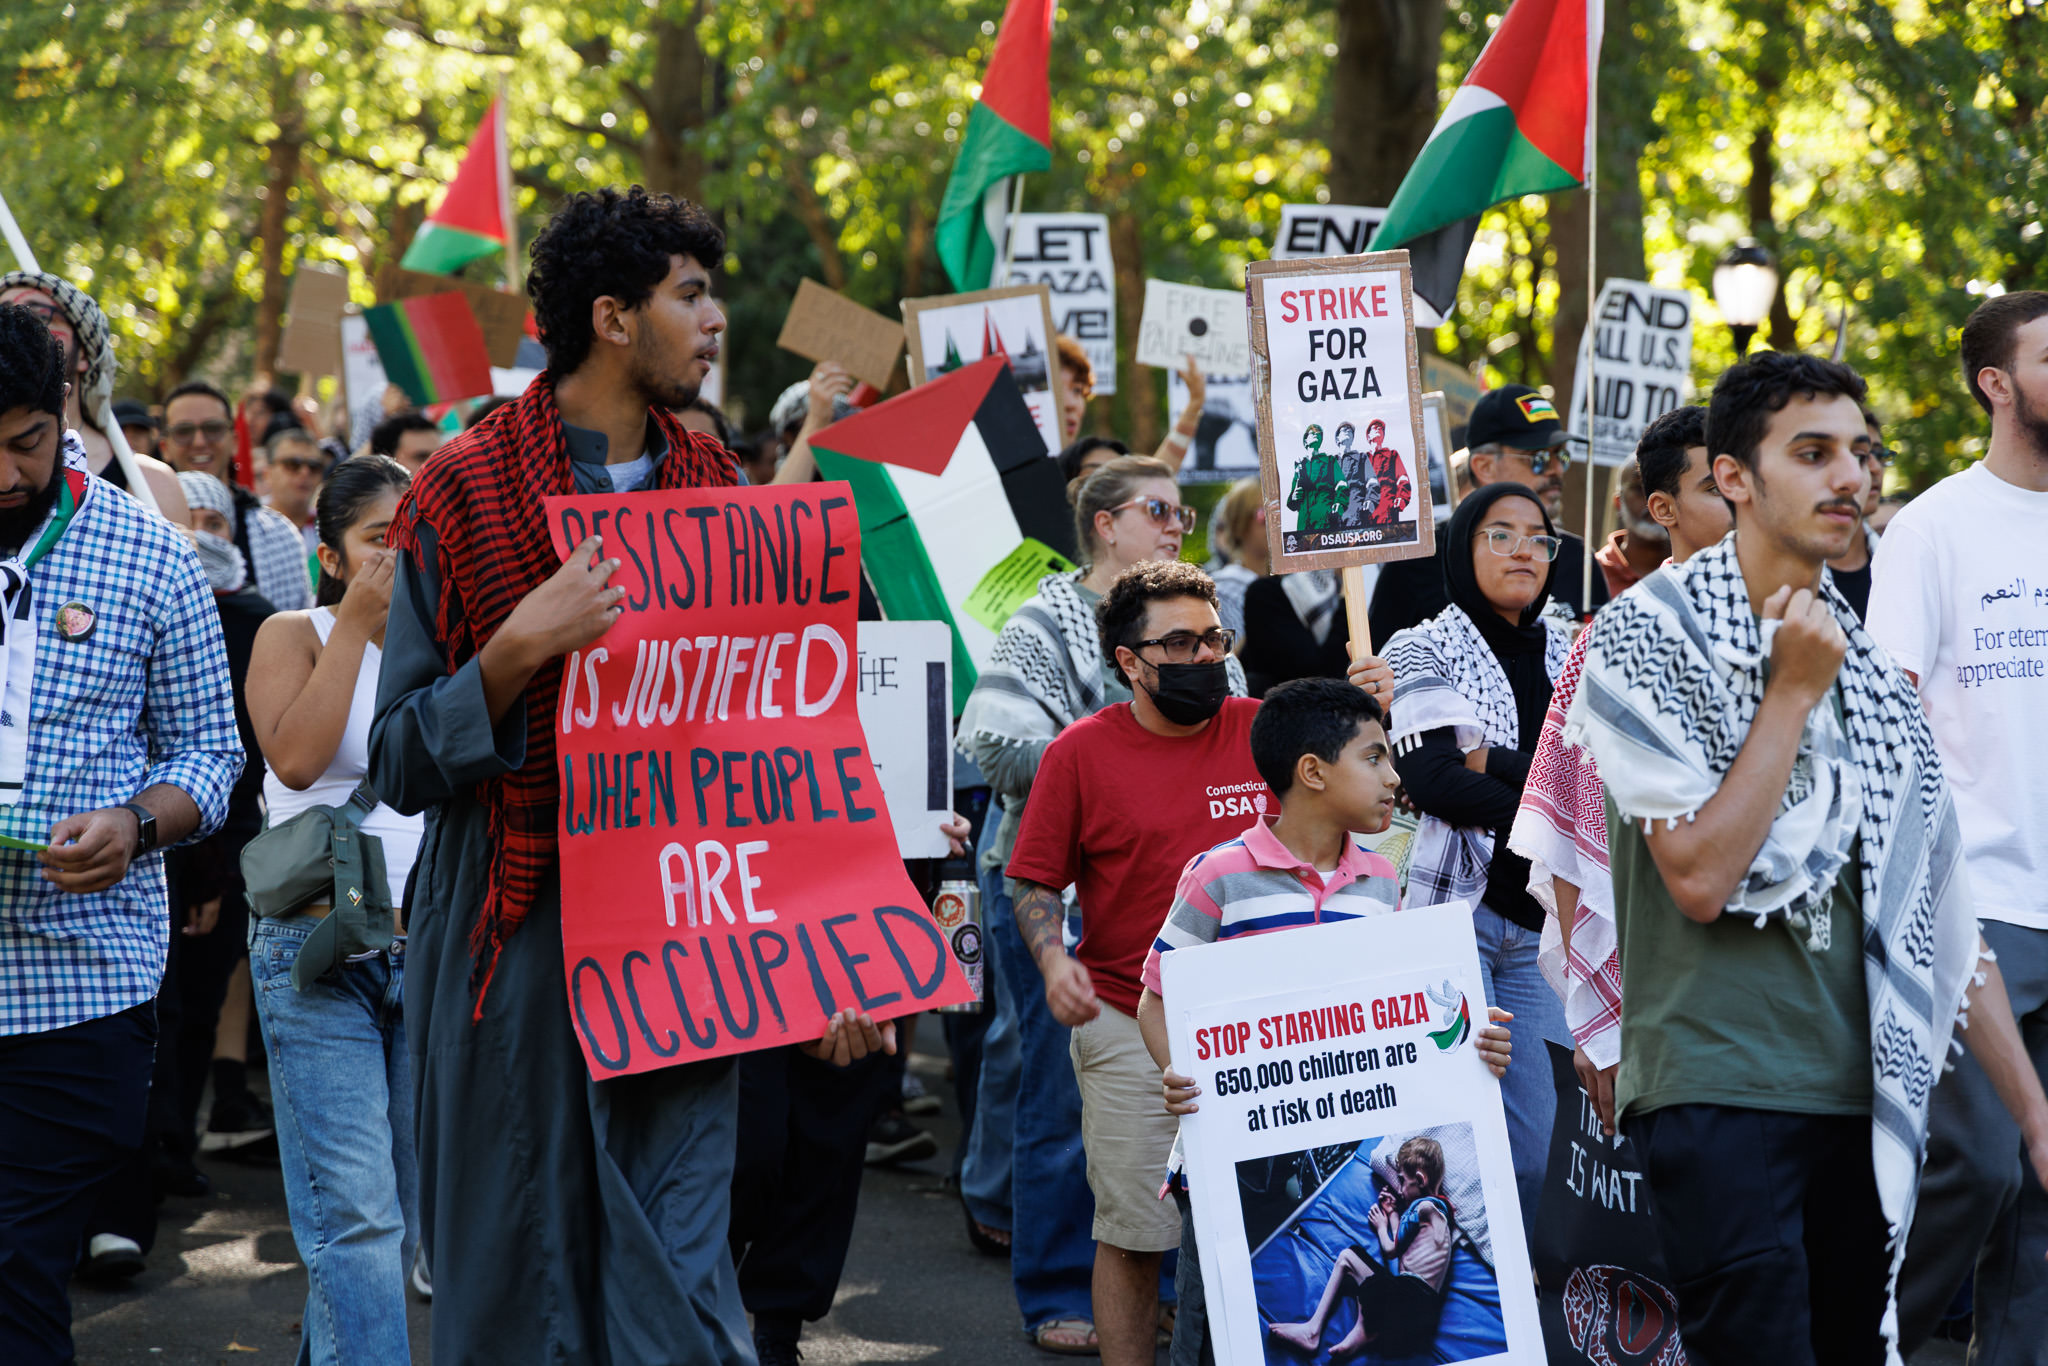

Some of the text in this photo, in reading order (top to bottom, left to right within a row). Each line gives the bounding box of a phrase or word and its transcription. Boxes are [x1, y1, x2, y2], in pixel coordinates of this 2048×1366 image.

[1004, 226, 1099, 262] LET
[1166, 289, 1231, 327] FREE
[1281, 285, 1388, 323] STRIKE
[1602, 291, 1688, 330] END
[1144, 319, 1249, 367] PALESTINE
[1309, 327, 1366, 362] FOR
[1587, 327, 1683, 370] ALL U.S.
[1298, 366, 1382, 403] GAZA
[1581, 376, 1677, 423] AID TO
[1320, 529, 1383, 546] DSAUSA.ORG
[1973, 627, 2004, 651] For
[563, 624, 848, 735] IS JUSTIFIED
[1956, 656, 2044, 688] appreciate
[565, 750, 676, 836] WHEN
[690, 746, 877, 829] PEOPLE
[1209, 796, 1254, 819] DSA
[659, 840, 777, 928] ARE
[571, 905, 947, 1071] OCCUPIED
[1196, 992, 1430, 1060] STOP STARVING GAZA
[1215, 1041, 1418, 1097] 650,000 children are
[1247, 1082, 1398, 1132] at risk of death
[1566, 1140, 1651, 1216] IS WAT
